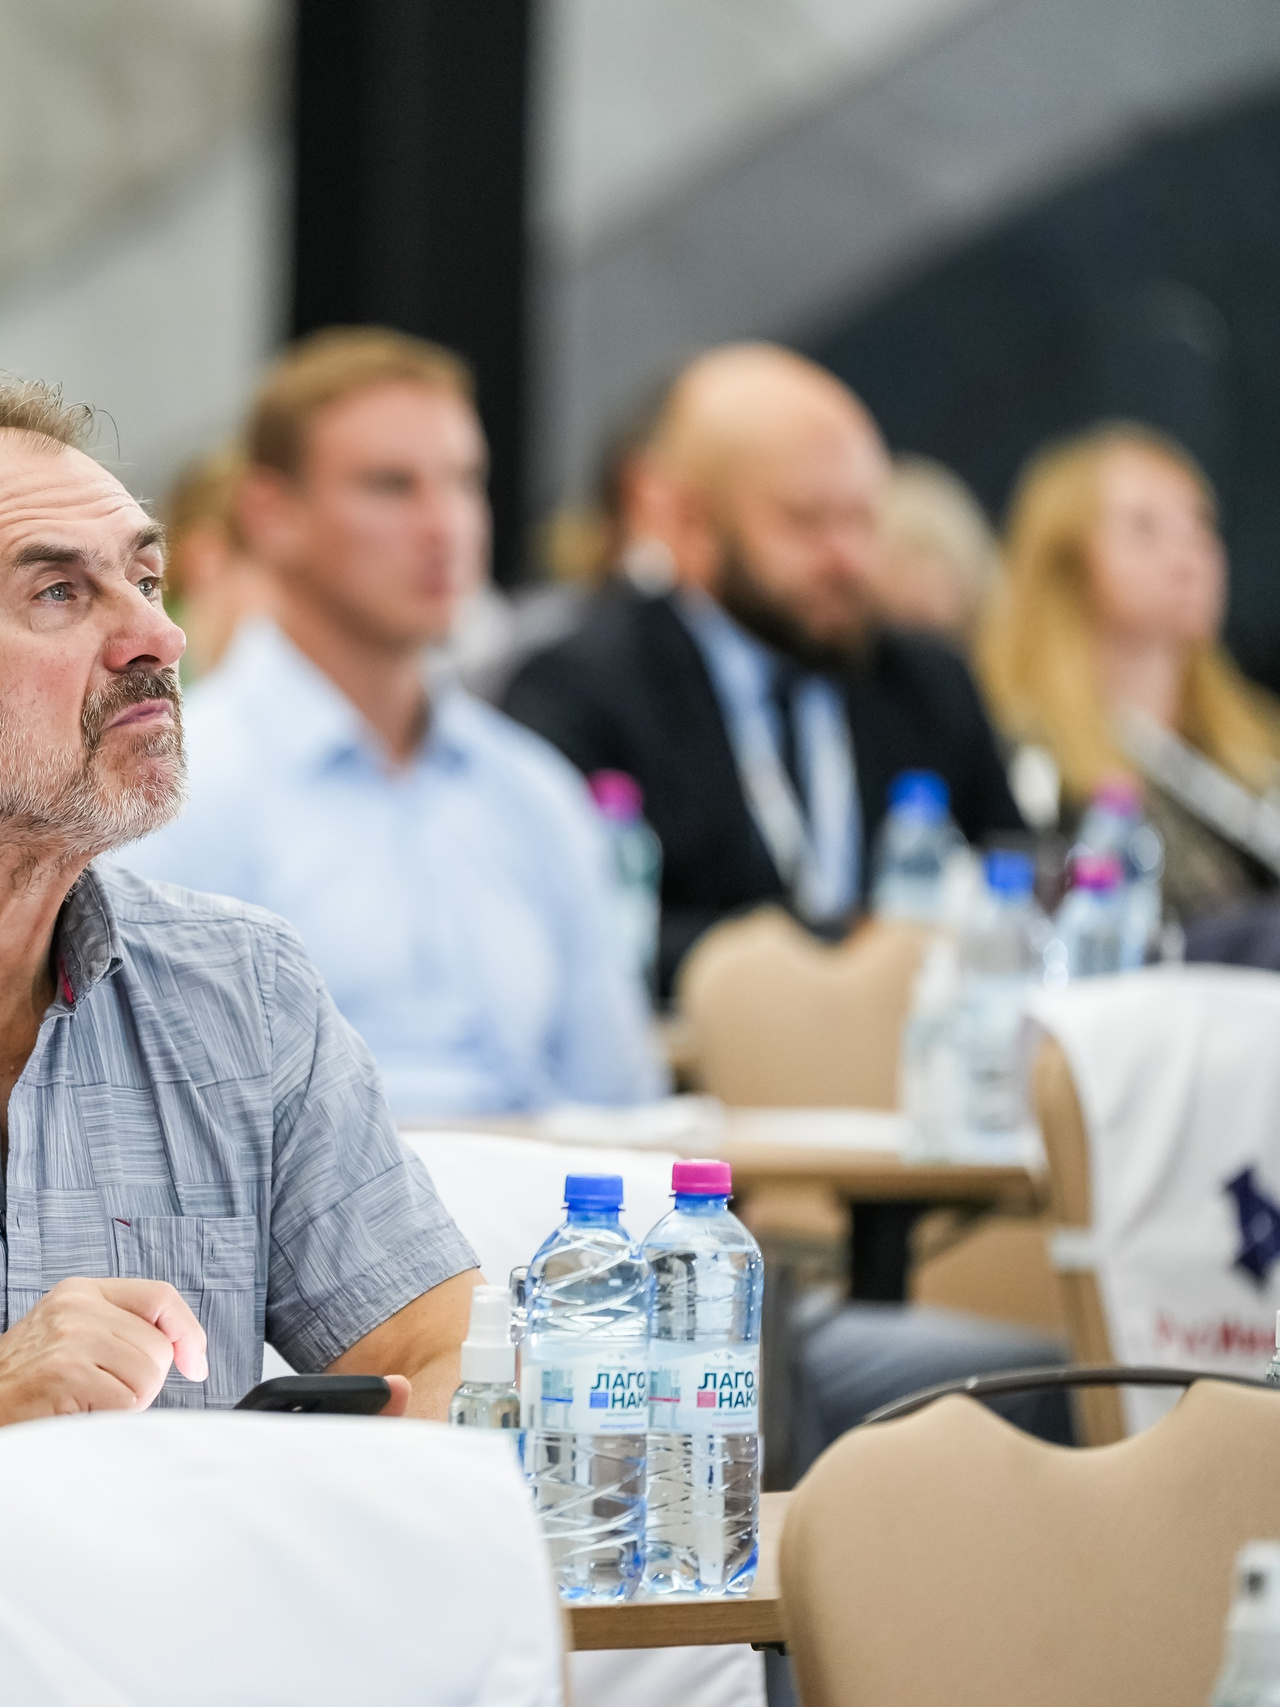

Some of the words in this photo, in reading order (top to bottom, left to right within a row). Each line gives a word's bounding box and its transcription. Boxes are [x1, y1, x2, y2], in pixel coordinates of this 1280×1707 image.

[591, 1371, 646, 1390] ЛАГО
[697, 1371, 754, 1390] ЛАГО
[612, 1389, 649, 1409] НАК
